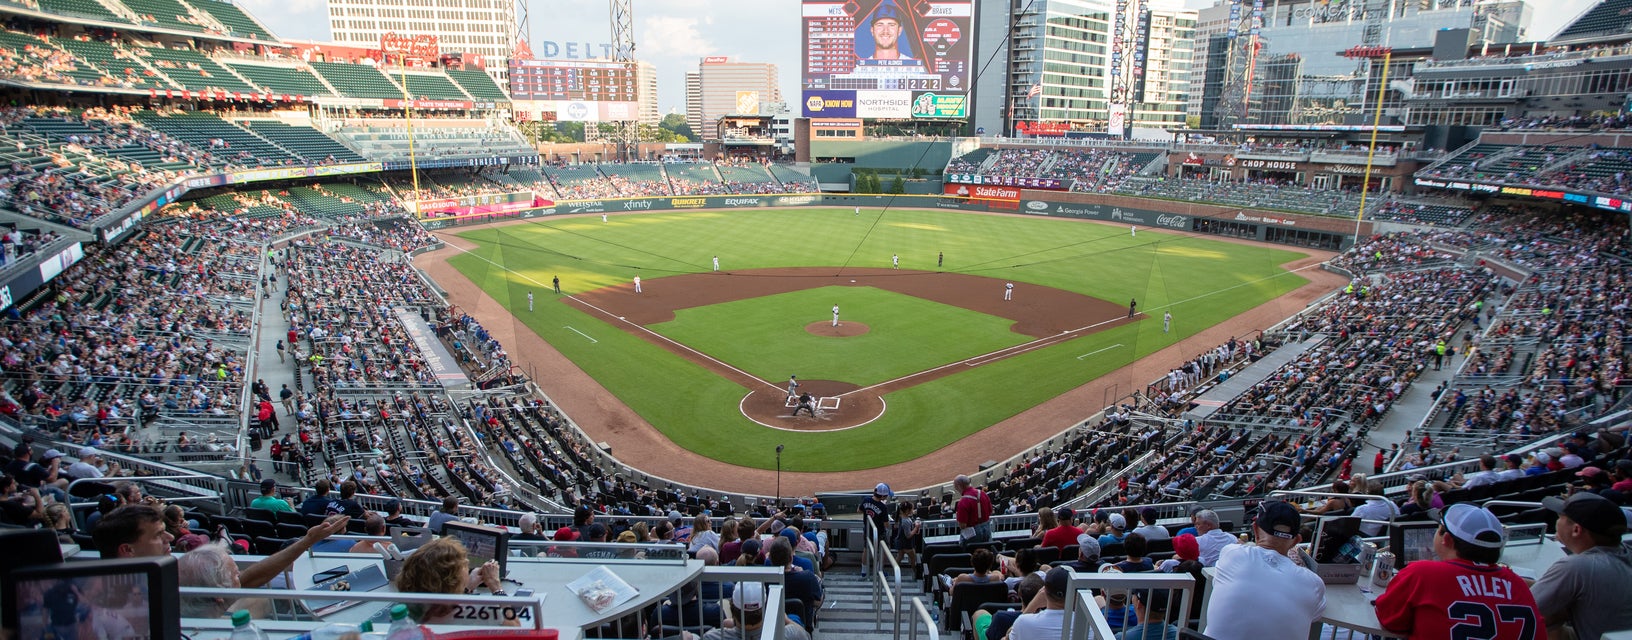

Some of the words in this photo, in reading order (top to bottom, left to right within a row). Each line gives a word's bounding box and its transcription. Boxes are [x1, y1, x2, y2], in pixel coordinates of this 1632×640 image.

[910, 80, 916, 89] 2
[921, 80, 927, 89] 2
[932, 80, 938, 89] 2
[1242, 160, 1265, 168] CHOP
[1266, 161, 1297, 170] HOUSE
[623, 200, 652, 211] xfinity
[725, 198, 759, 206] EQUIFAX
[1156, 214, 1187, 228] Coca-Cola
[1456, 575, 1512, 600] RILEY
[1447, 600, 1537, 640] 27
